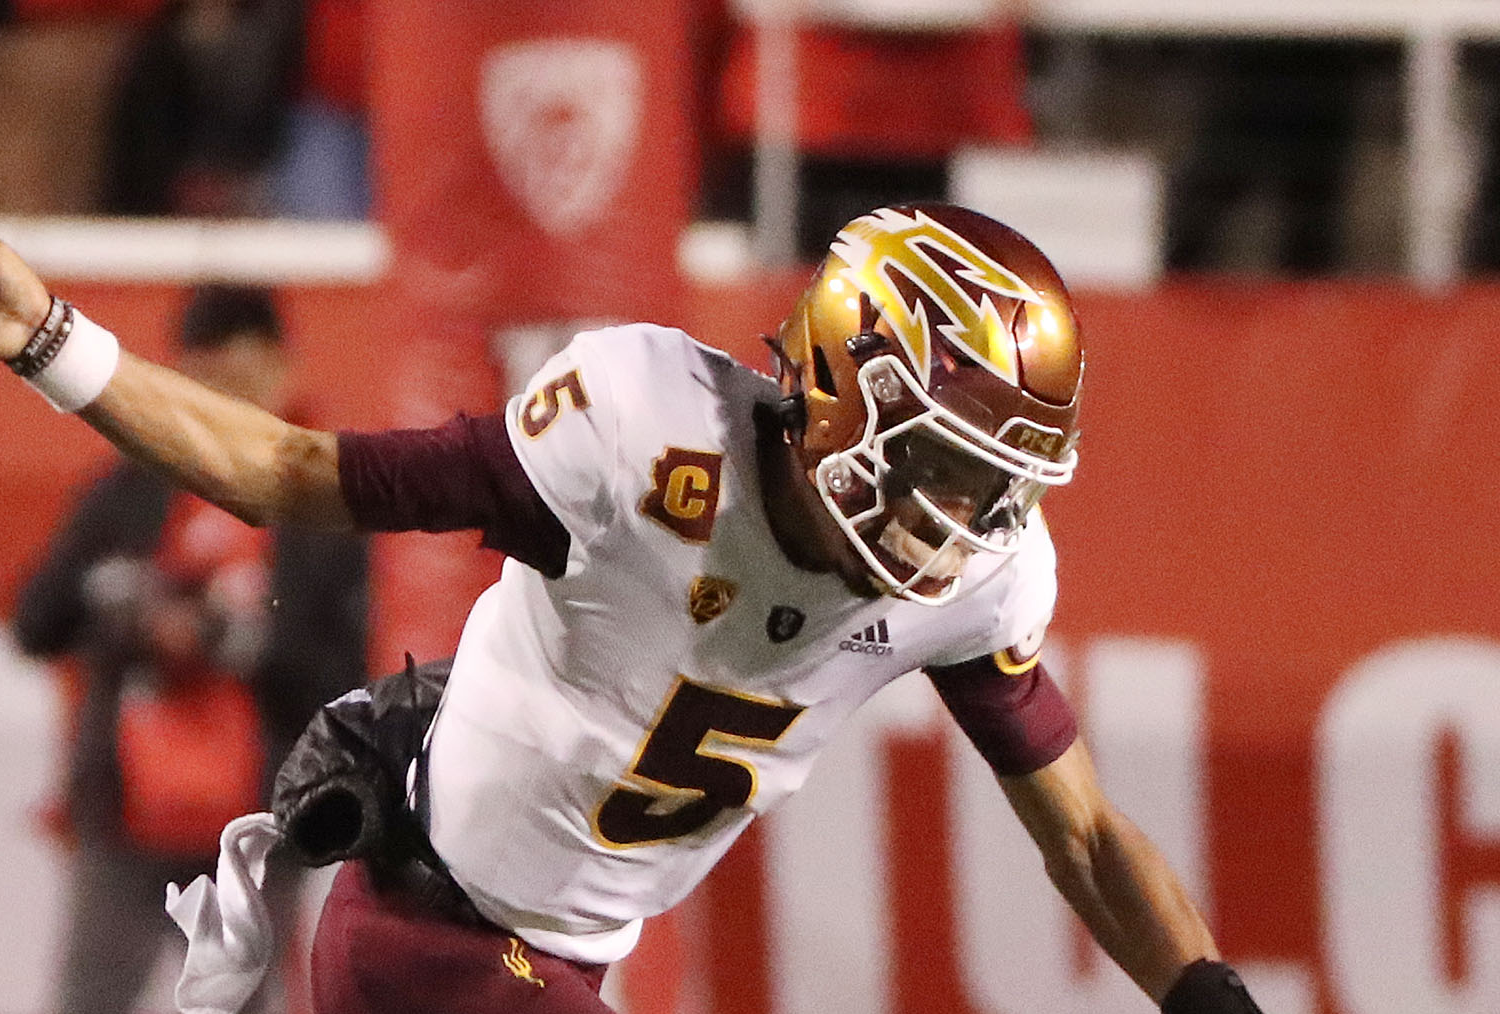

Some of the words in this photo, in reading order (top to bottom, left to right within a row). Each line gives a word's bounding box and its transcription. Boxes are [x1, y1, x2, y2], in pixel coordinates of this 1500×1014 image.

[518, 367, 592, 441] 5
[664, 465, 709, 518] C
[592, 675, 808, 849] 5
